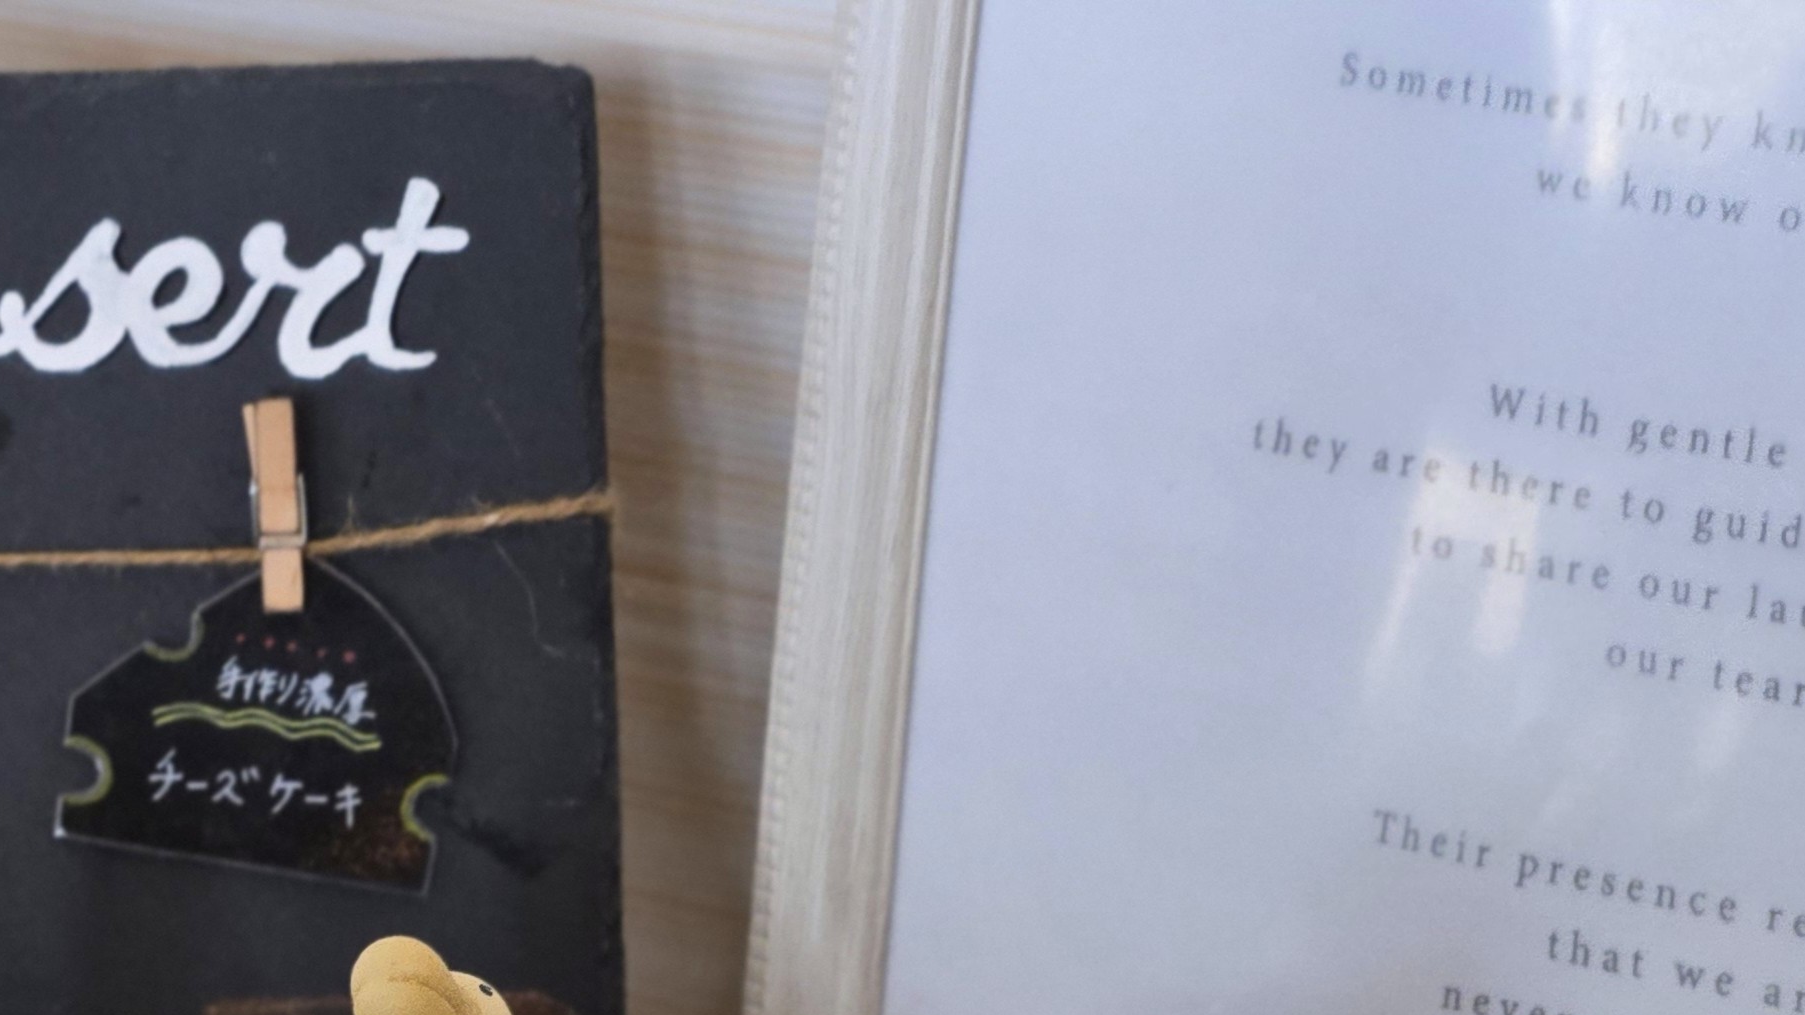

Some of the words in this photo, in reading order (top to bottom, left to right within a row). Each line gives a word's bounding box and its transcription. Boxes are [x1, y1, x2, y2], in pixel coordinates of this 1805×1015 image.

[1340, 51, 1587, 122] Sometimes
[1617, 94, 1724, 151] they
[1536, 168, 1591, 201] we
[1619, 170, 1749, 225] know
[1490, 382, 1600, 438] With
[1626, 415, 1788, 469] gentle
[1252, 415, 1349, 474] they
[1371, 448, 1444, 485] are
[1467, 458, 1593, 511] there
[1620, 487, 1666, 524] to
[1410, 524, 1454, 561] to
[1479, 536, 1612, 590] share
[1638, 571, 1721, 611] our
[215, 654, 378, 725] 手作り濃厚
[1605, 643, 1686, 681] our
[148, 748, 364, 830] チーズケーキ
[1372, 808, 1492, 869] Their
[1513, 852, 1739, 925] presence
[1548, 929, 1645, 979] that
[1674, 959, 1734, 997] we
